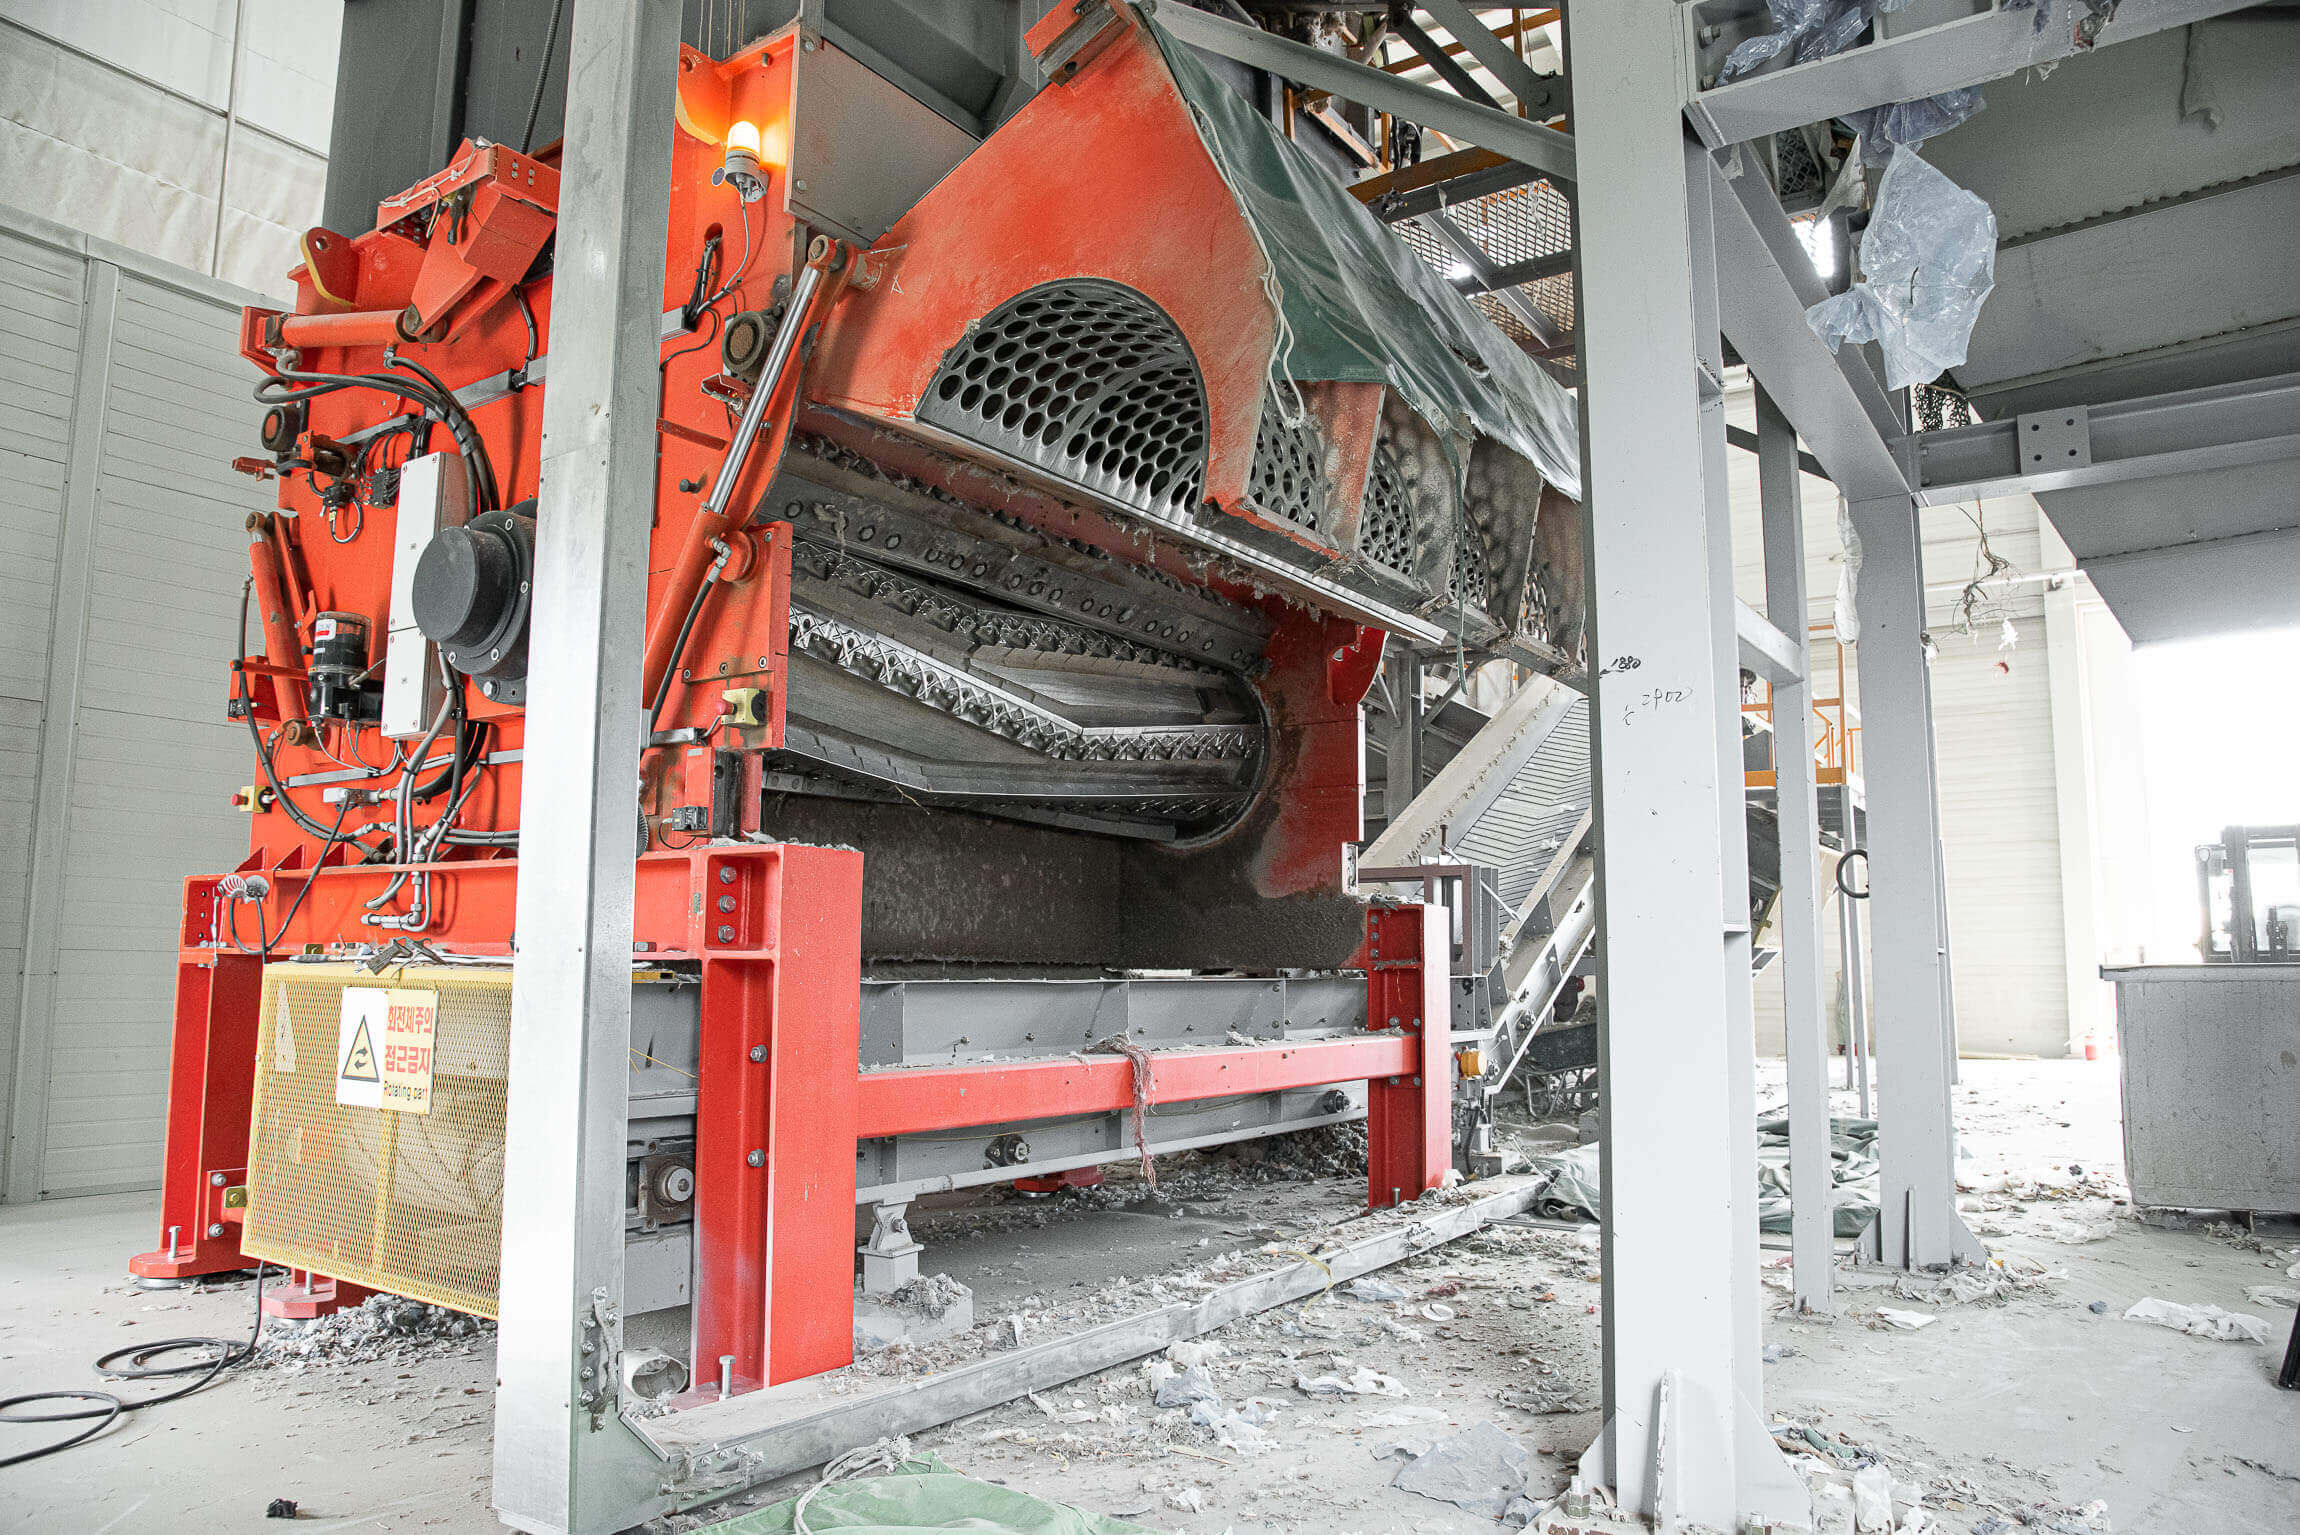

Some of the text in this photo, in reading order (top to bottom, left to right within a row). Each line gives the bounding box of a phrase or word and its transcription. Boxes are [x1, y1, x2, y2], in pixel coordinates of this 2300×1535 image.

[387, 1005, 434, 1034] 회전체주의
[385, 1045, 431, 1075] 접근금지
[384, 1080, 412, 1101] Rotating
